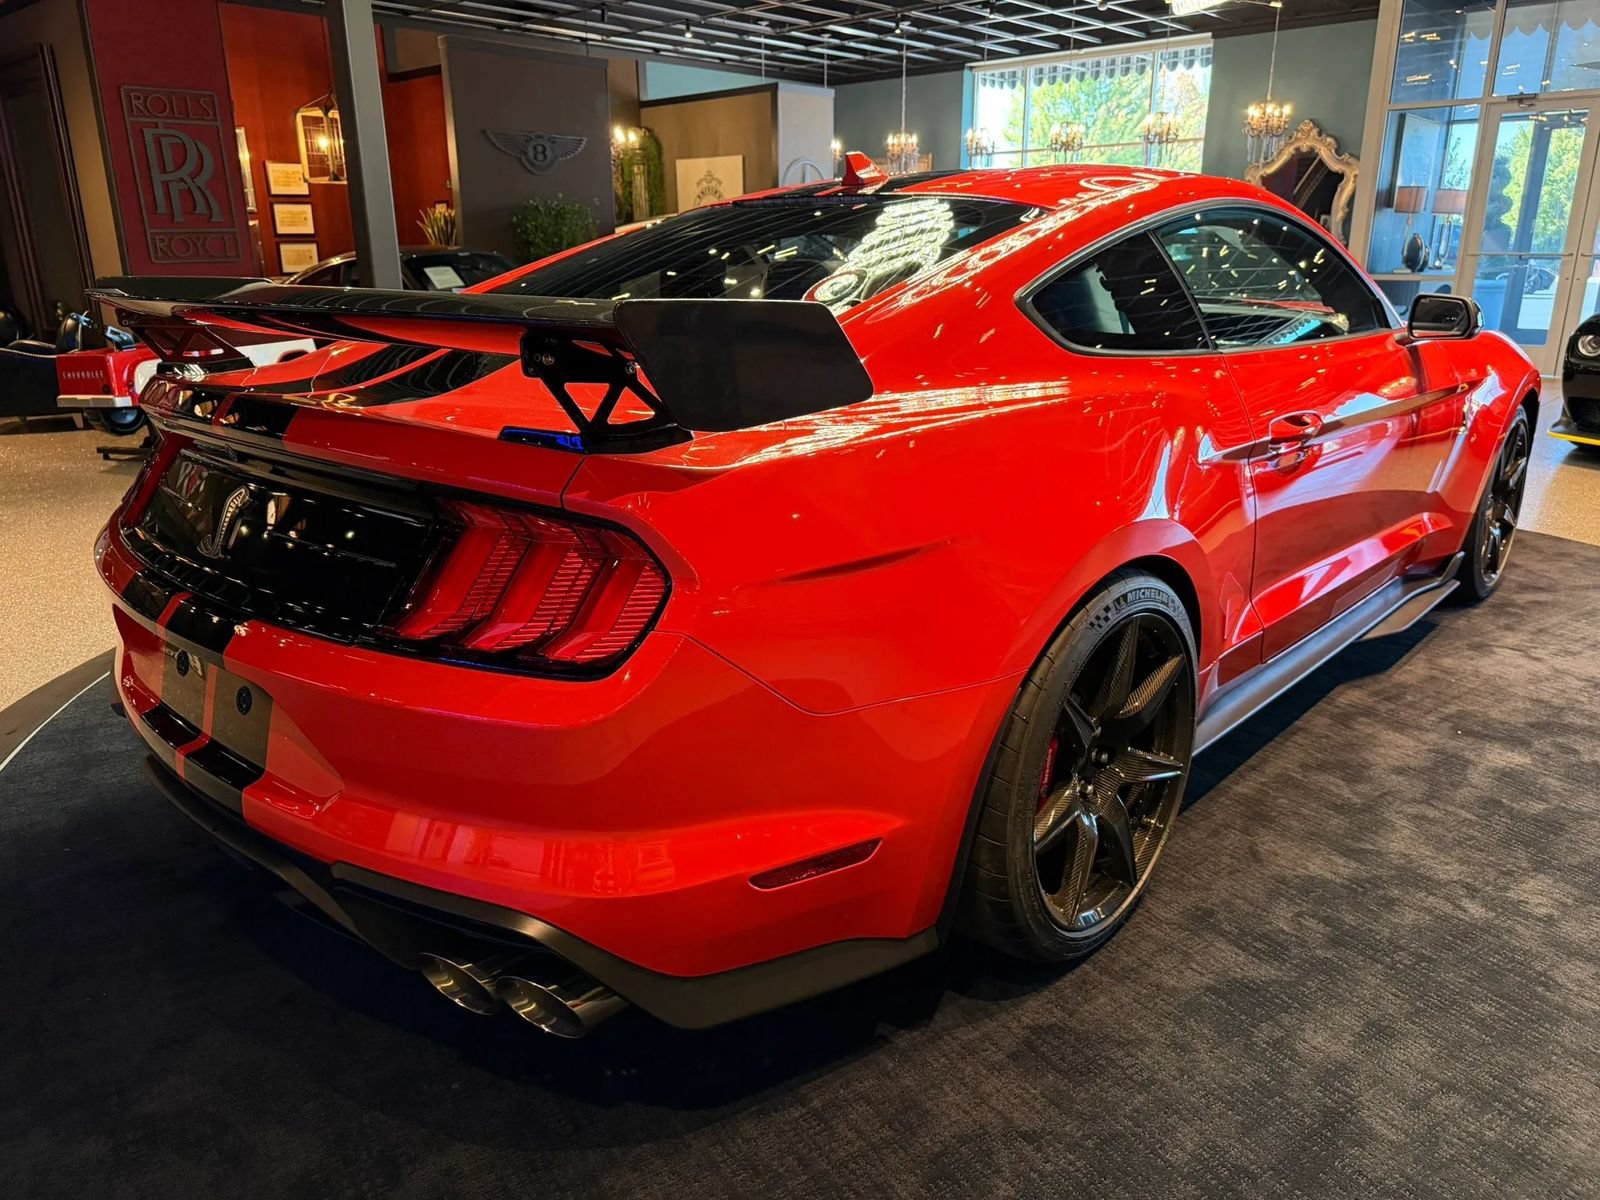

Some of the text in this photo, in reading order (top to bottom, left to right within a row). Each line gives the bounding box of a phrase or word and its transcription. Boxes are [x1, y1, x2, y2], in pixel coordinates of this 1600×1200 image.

[130, 92, 215, 120] ROLLS
[154, 234, 237, 258] ROYCE
[1127, 588, 1169, 604] MICHELIN
